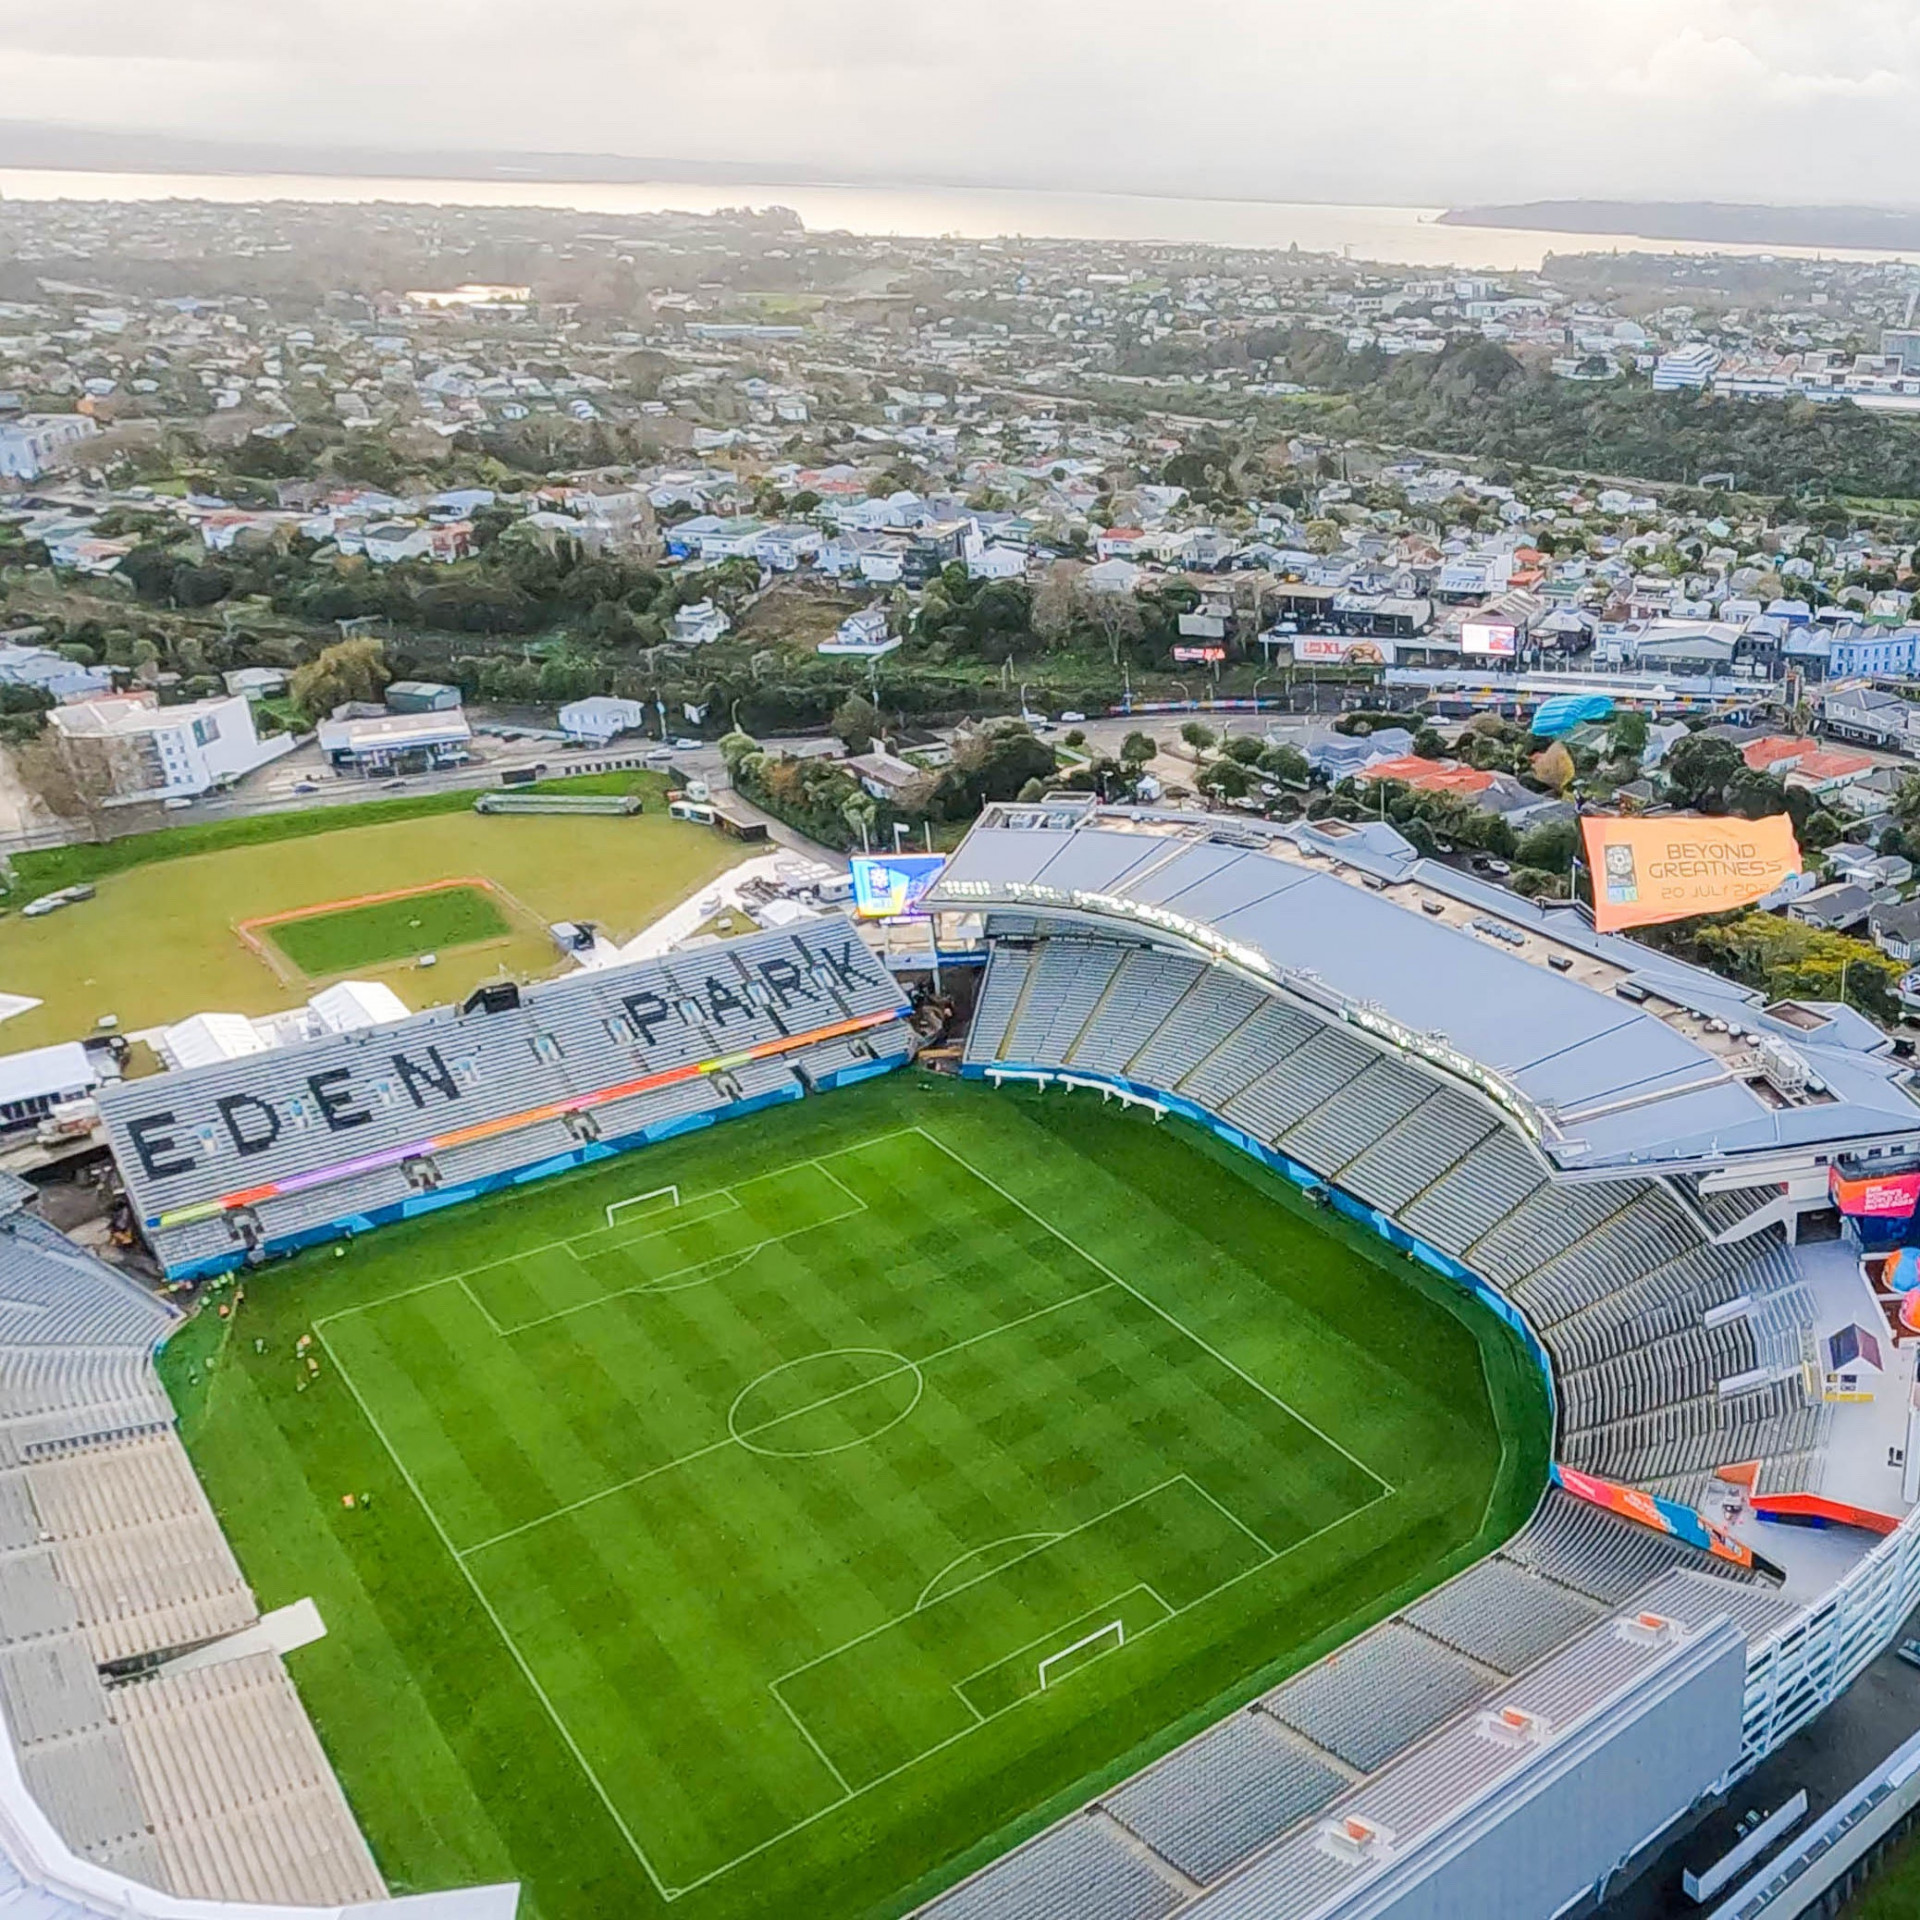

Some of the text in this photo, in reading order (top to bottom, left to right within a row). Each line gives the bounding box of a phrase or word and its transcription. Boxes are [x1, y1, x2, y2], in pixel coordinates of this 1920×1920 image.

[1666, 843, 1756, 860] BEYOND
[1648, 860, 1783, 878] GREATNESS
[1661, 887, 1685, 900] 20
[1732, 883, 1770, 898] 202
[126, 942, 880, 1181] EDEN PARK
